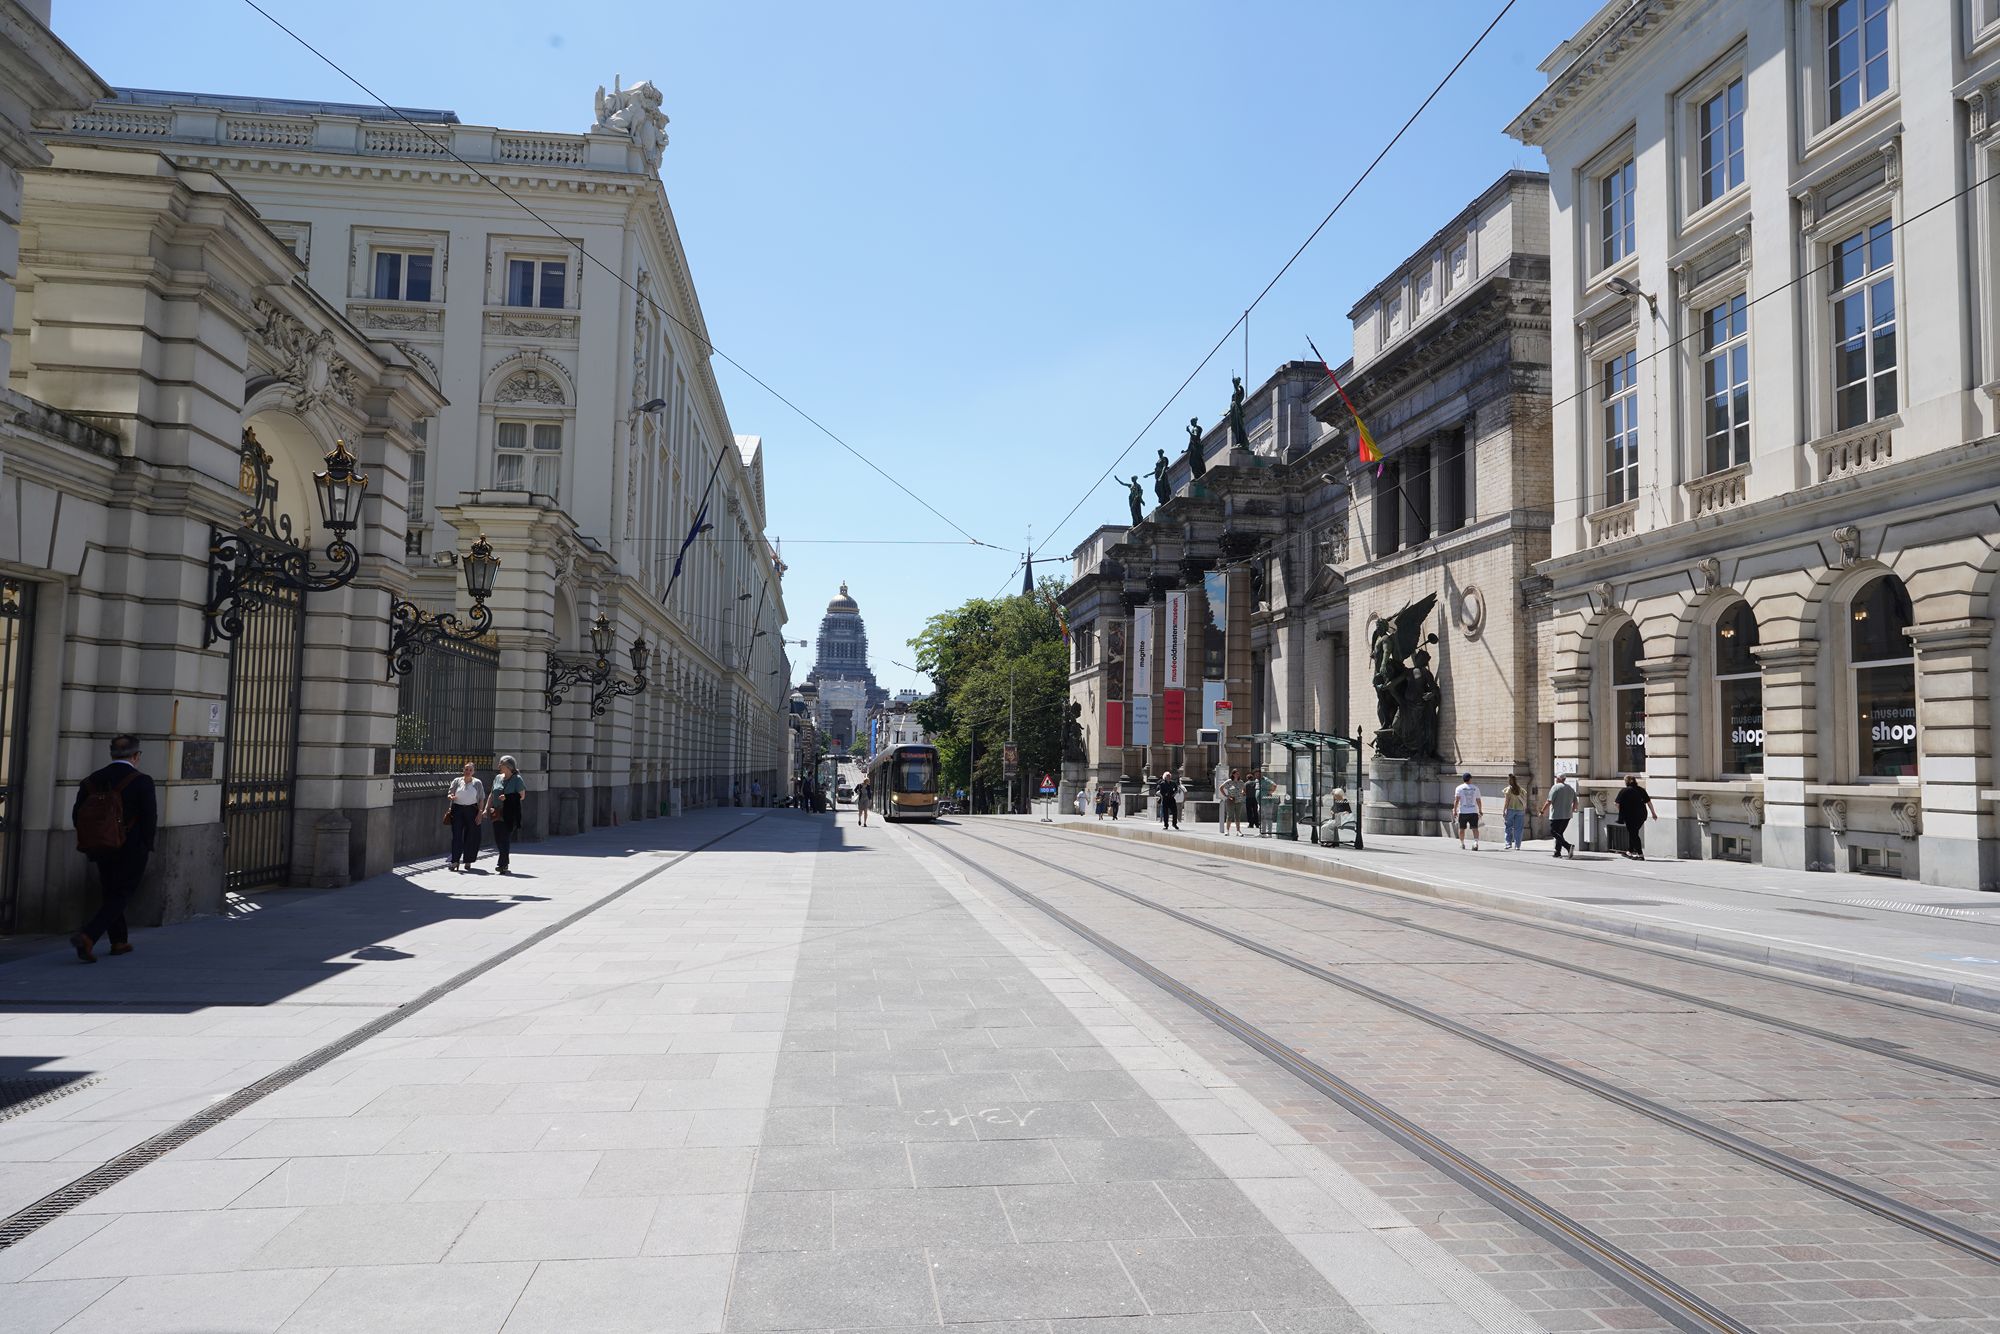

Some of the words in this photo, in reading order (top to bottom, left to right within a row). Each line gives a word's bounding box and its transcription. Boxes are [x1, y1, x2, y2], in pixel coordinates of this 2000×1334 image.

[1870, 707, 1915, 719] museum
[1731, 726, 1764, 746] shop
[1871, 721, 1916, 744] shop
